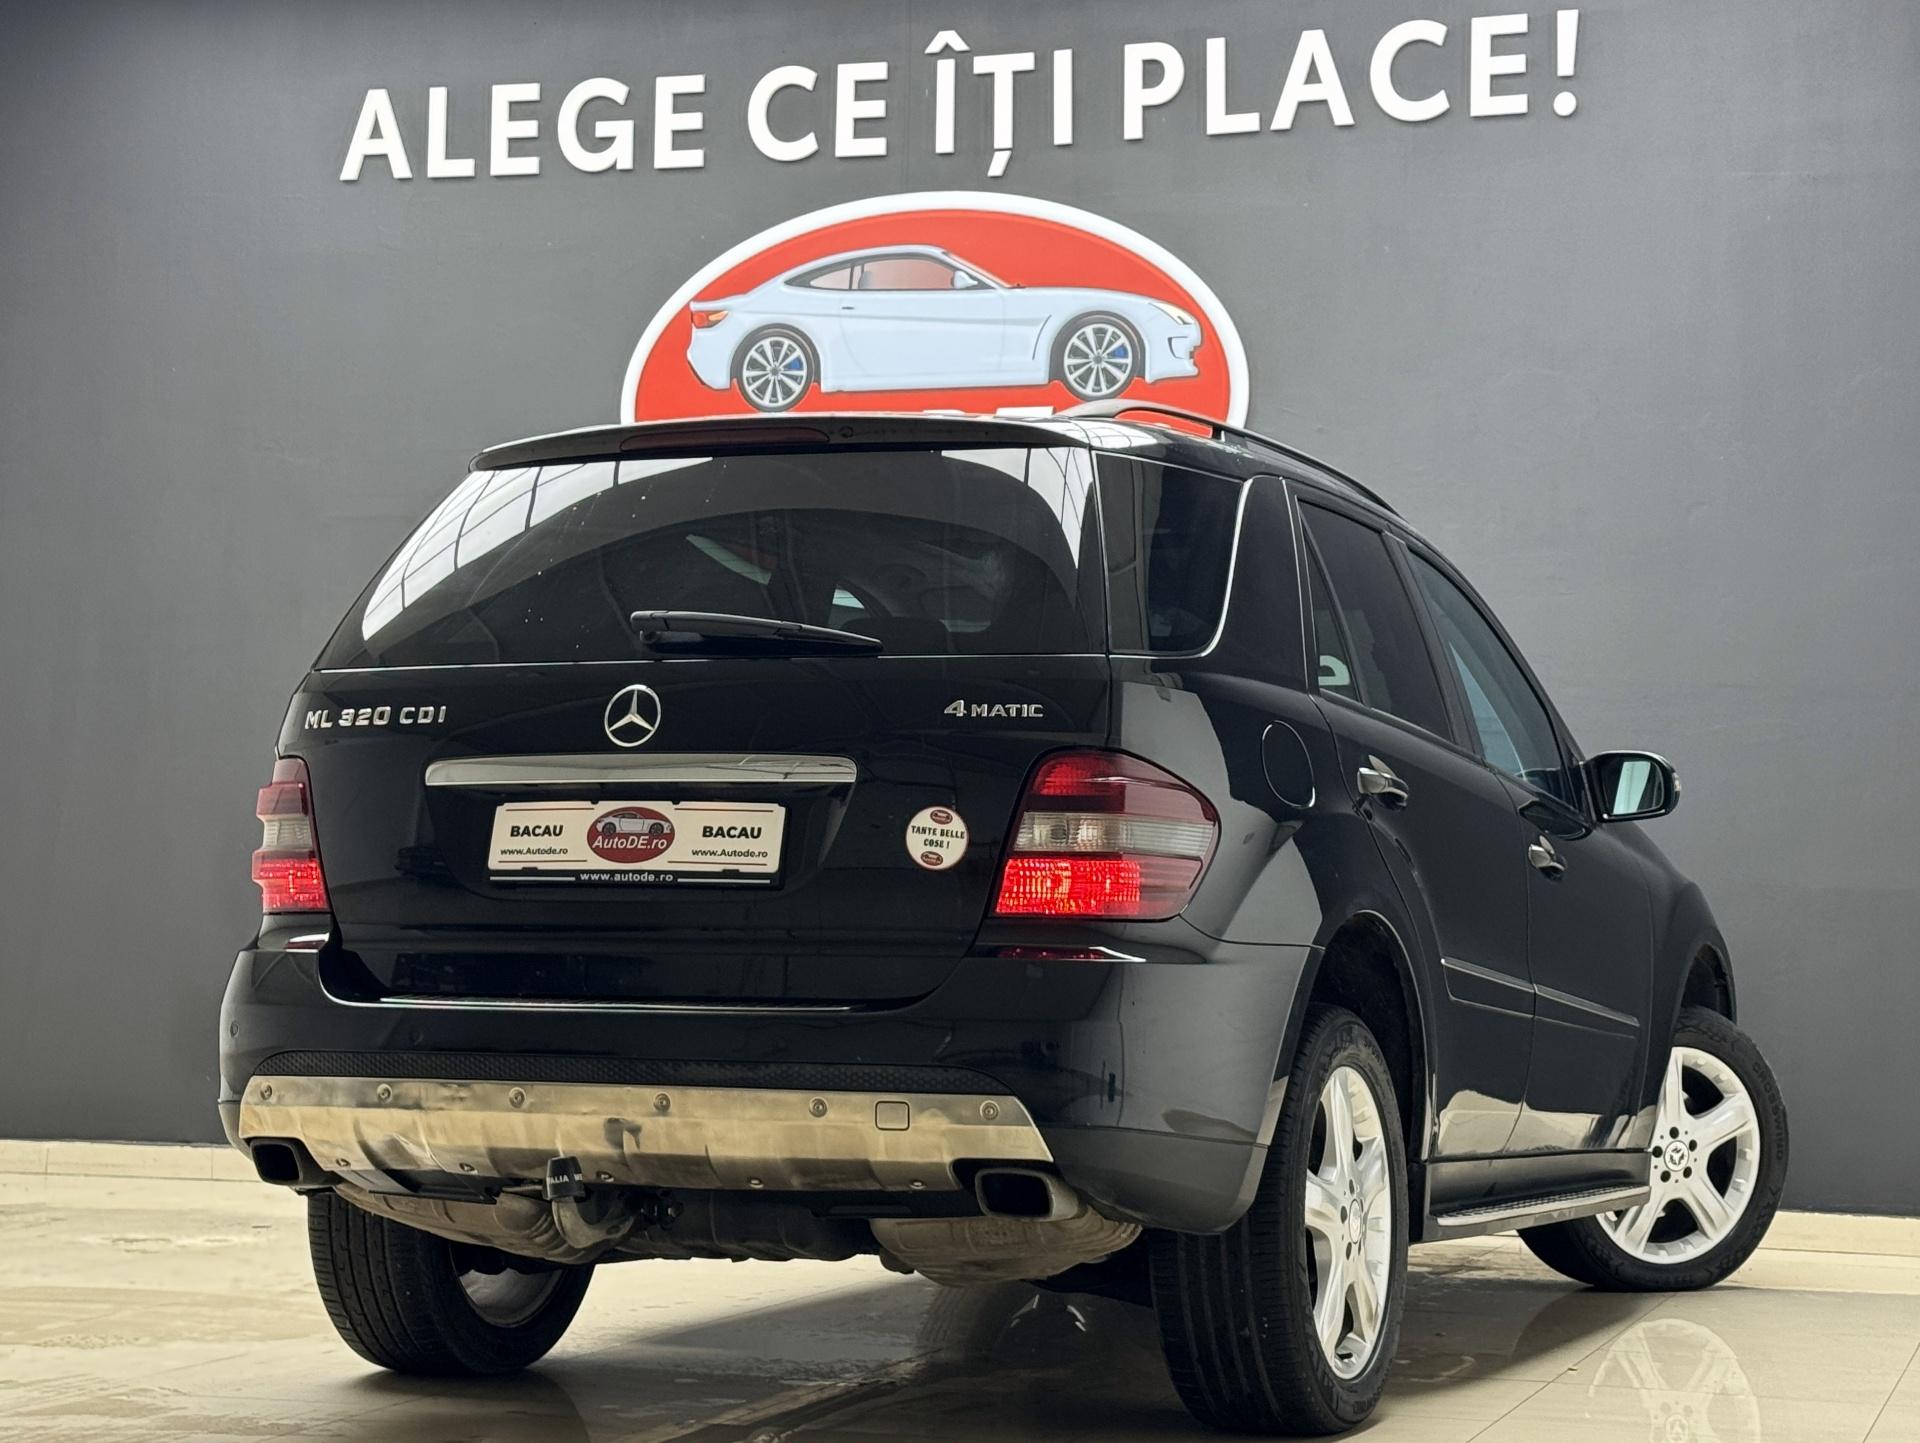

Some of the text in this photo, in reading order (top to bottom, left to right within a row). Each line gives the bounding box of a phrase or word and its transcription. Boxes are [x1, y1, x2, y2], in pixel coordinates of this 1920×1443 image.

[339, 73, 706, 182] ALEGE
[746, 61, 889, 163] CE
[1123, 8, 1580, 141] PLACE!
[304, 705, 447, 730] ML 320 CDI
[510, 825, 564, 838] BACAU
[702, 826, 762, 839] BACAU
[911, 825, 966, 840] TANTE BELLE
[591, 835, 668, 850] AutoDE.ro
[923, 838, 945, 849] COSE
[500, 847, 568, 855] www.Autode.ro
[691, 849, 769, 858] www.Autode.ro
[580, 872, 674, 882] www.autode.ro
